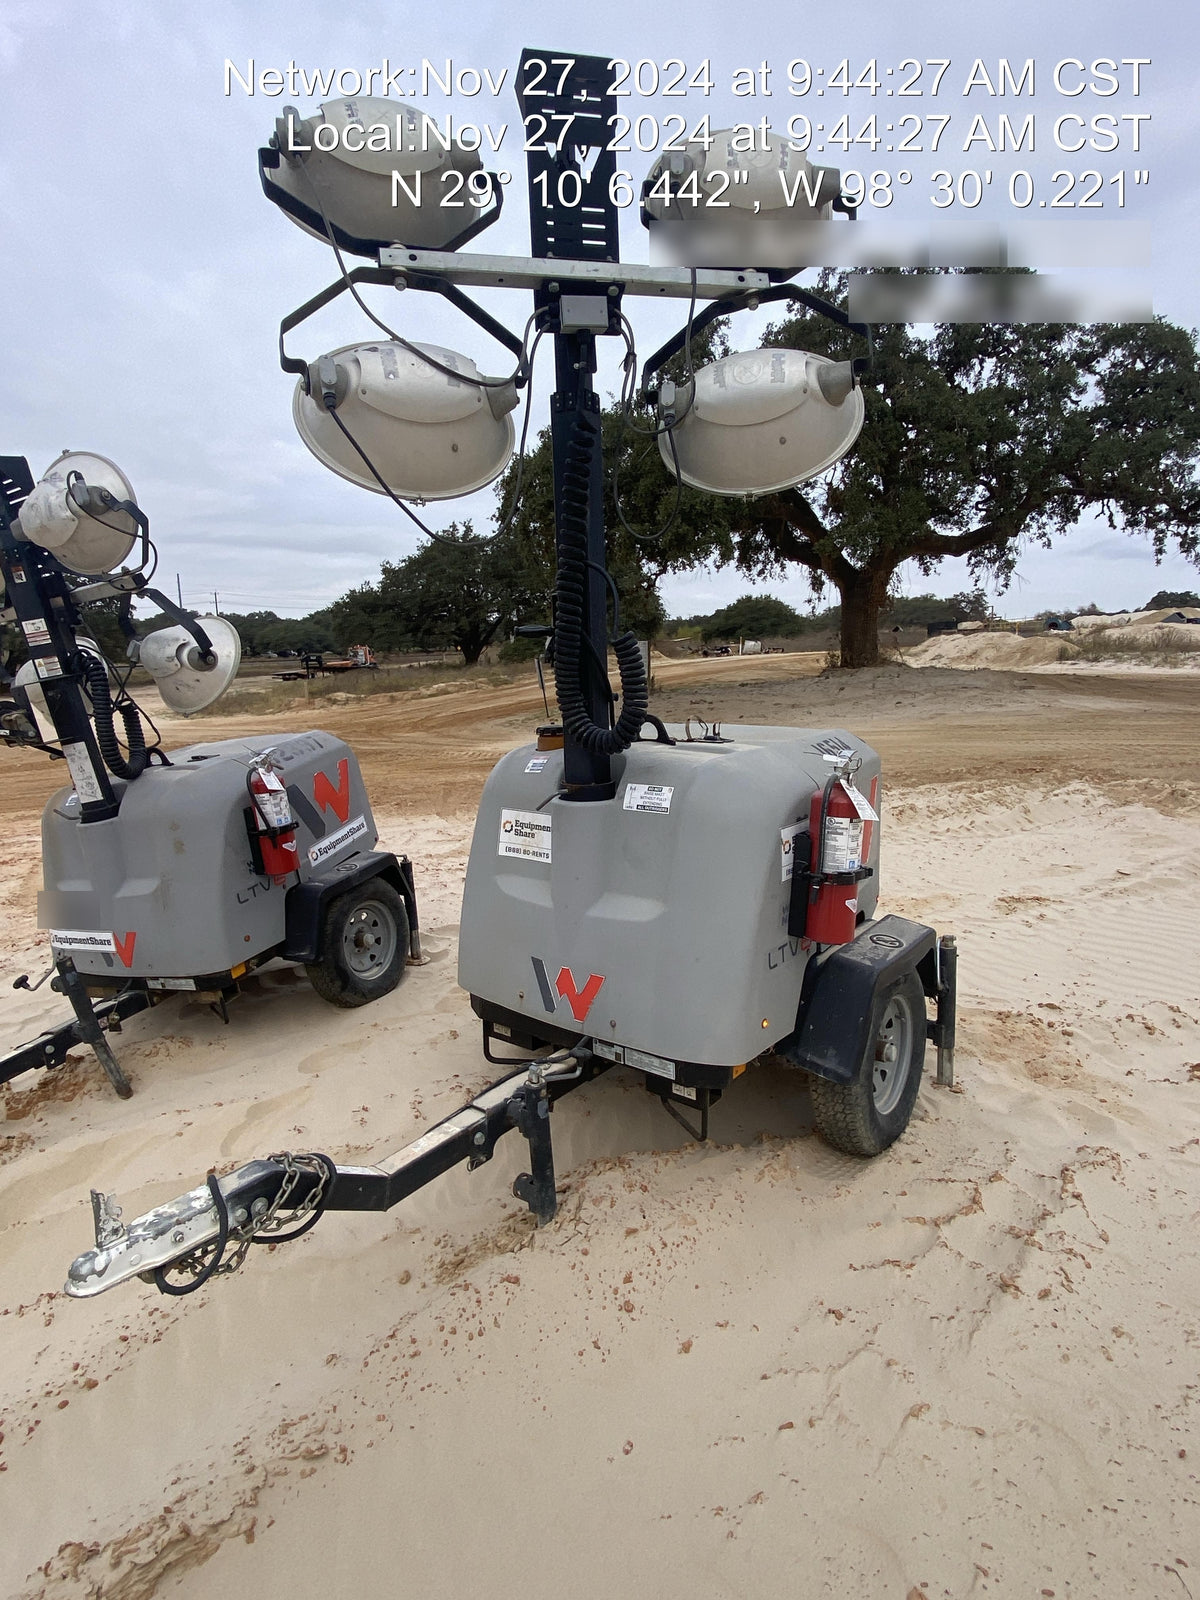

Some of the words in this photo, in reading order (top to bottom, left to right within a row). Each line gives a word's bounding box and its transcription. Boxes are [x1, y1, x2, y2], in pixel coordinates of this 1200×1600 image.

[514, 819, 551, 833] Equipmen
[318, 822, 366, 856] EquipmentShare
[514, 828, 536, 839] Share
[54, 934, 112, 946] EquipmentShare
